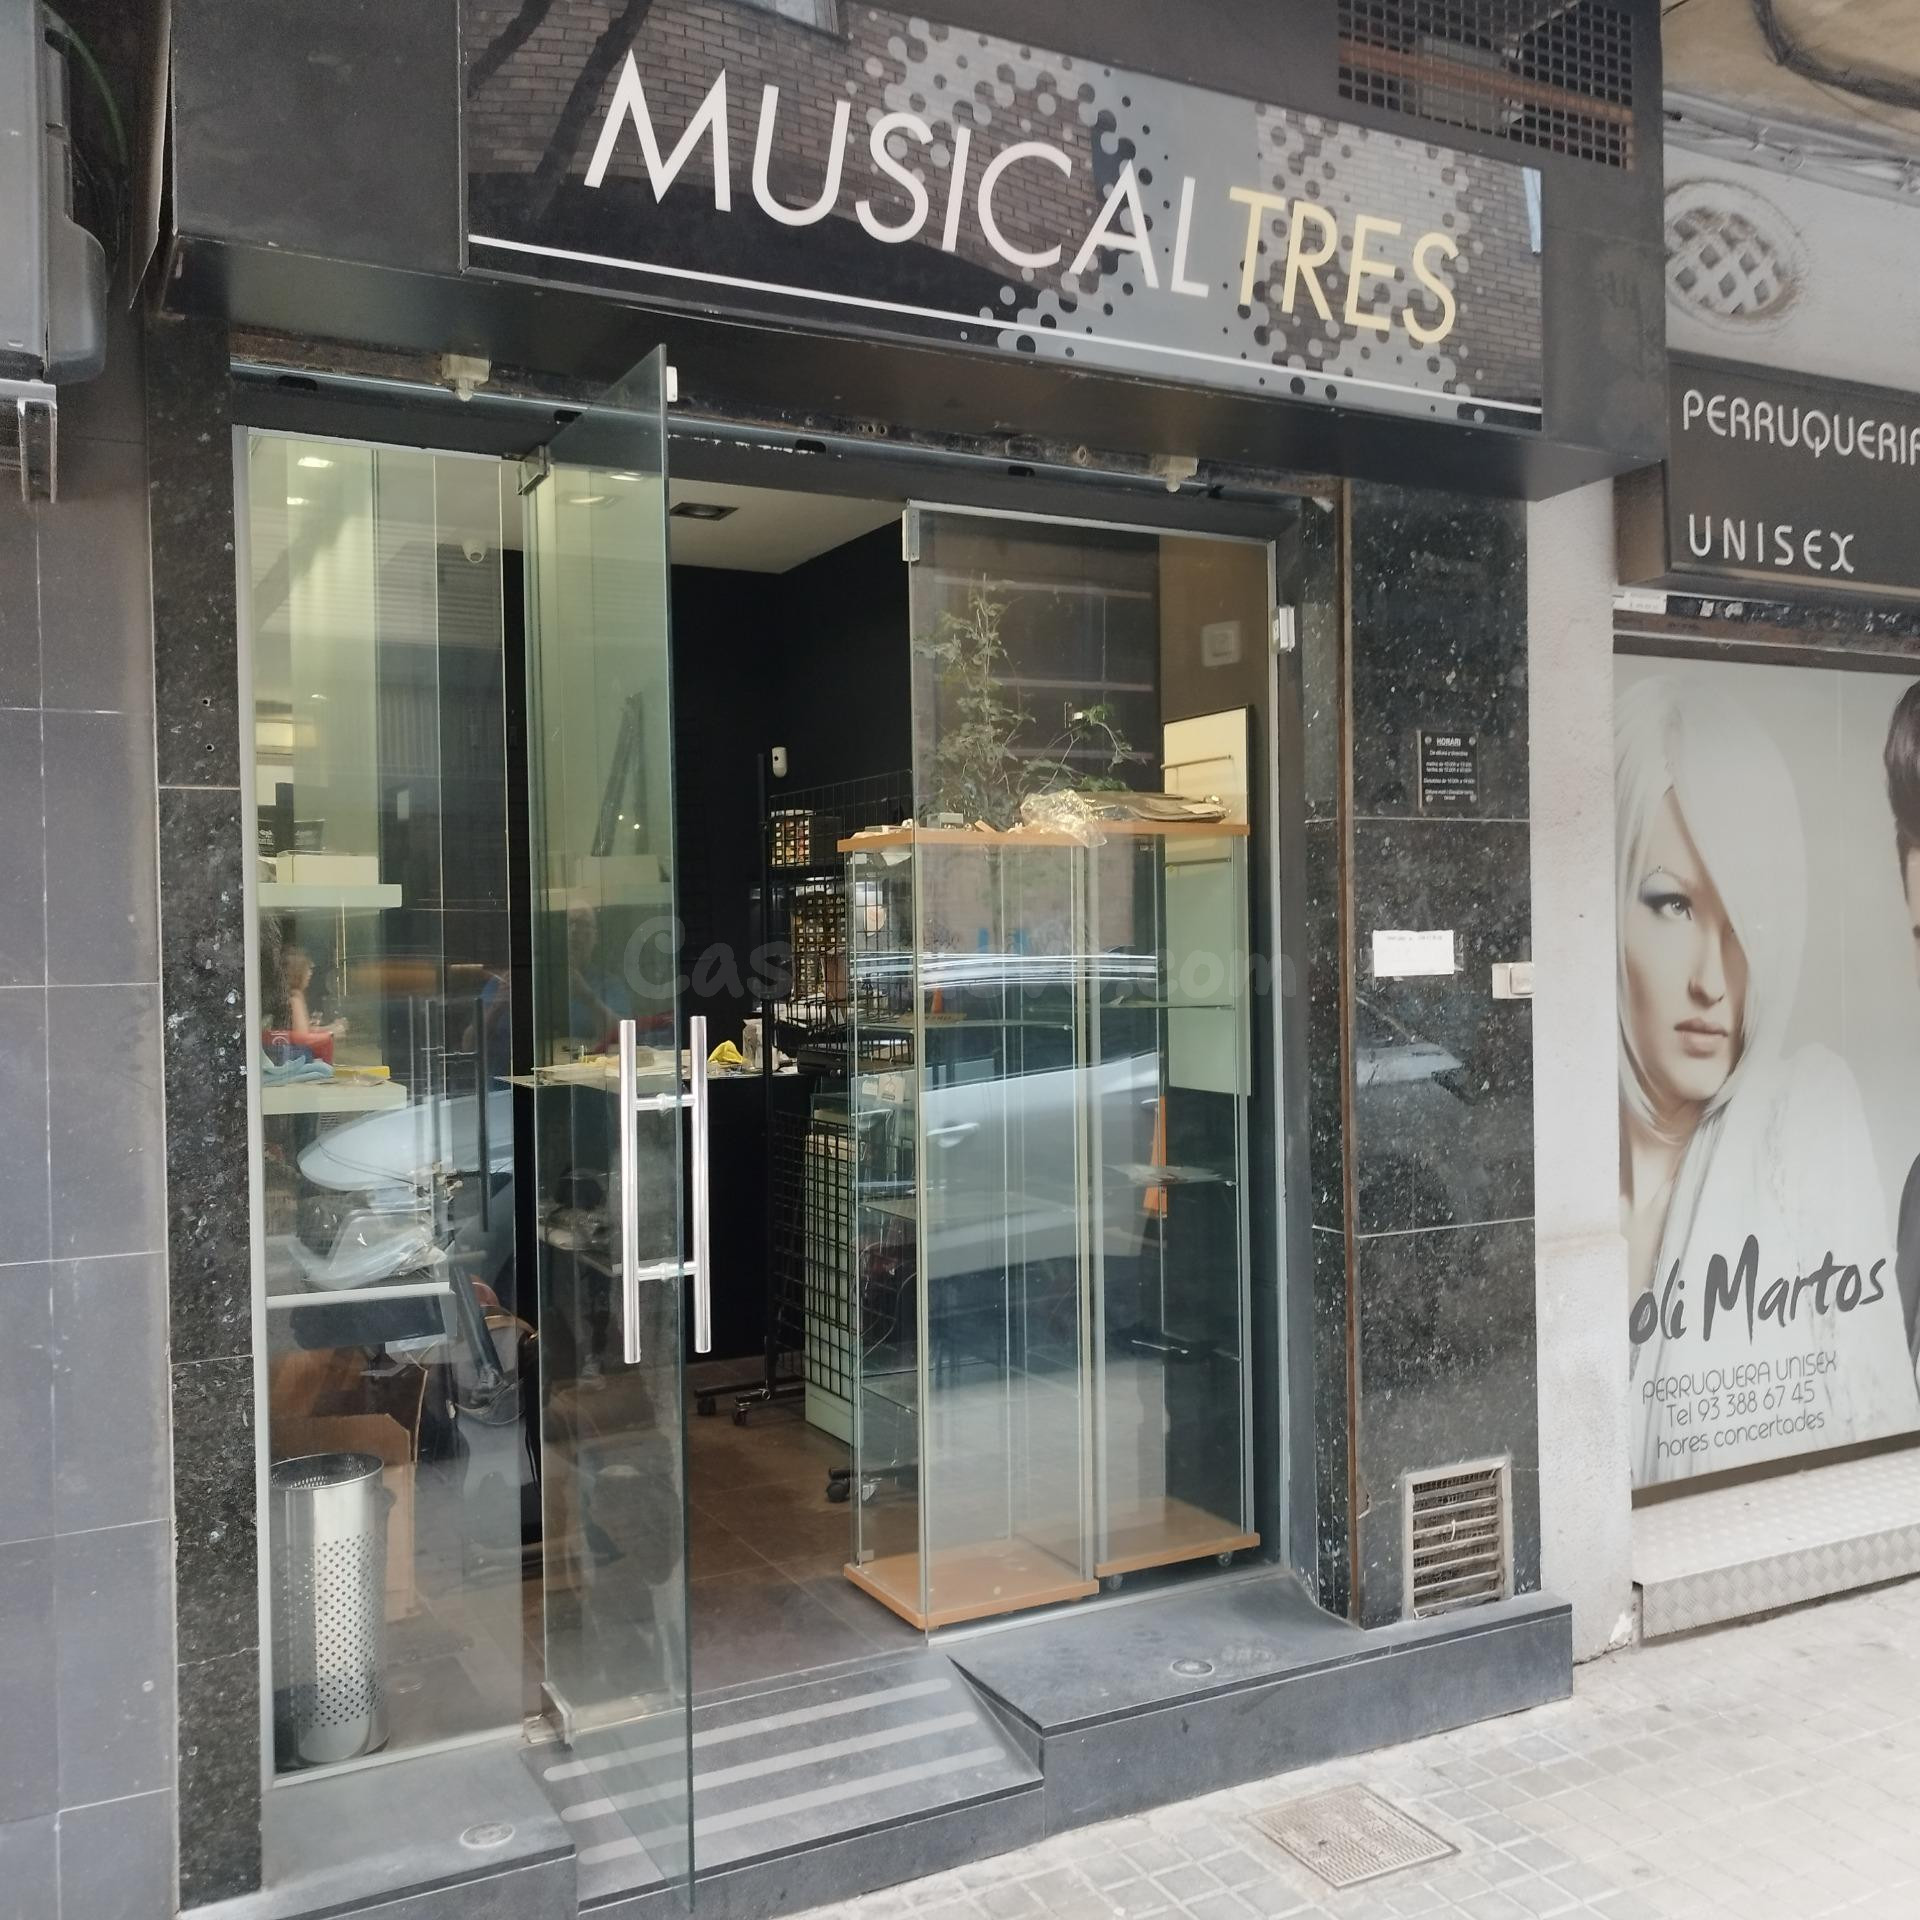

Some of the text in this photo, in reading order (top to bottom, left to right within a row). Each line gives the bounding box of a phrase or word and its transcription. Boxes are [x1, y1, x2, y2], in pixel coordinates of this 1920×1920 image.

[584, 48, 1460, 345] MUSICAL TRES
[1688, 513, 1854, 574] UNISEX
[1703, 1234, 1886, 1346] Martos
[1643, 1350, 1837, 1404] PERRUQUERA UNISEX
[1666, 1379, 1815, 1428] Tel 93 388 67 45
[1657, 1408, 1825, 1459] hores concertades
